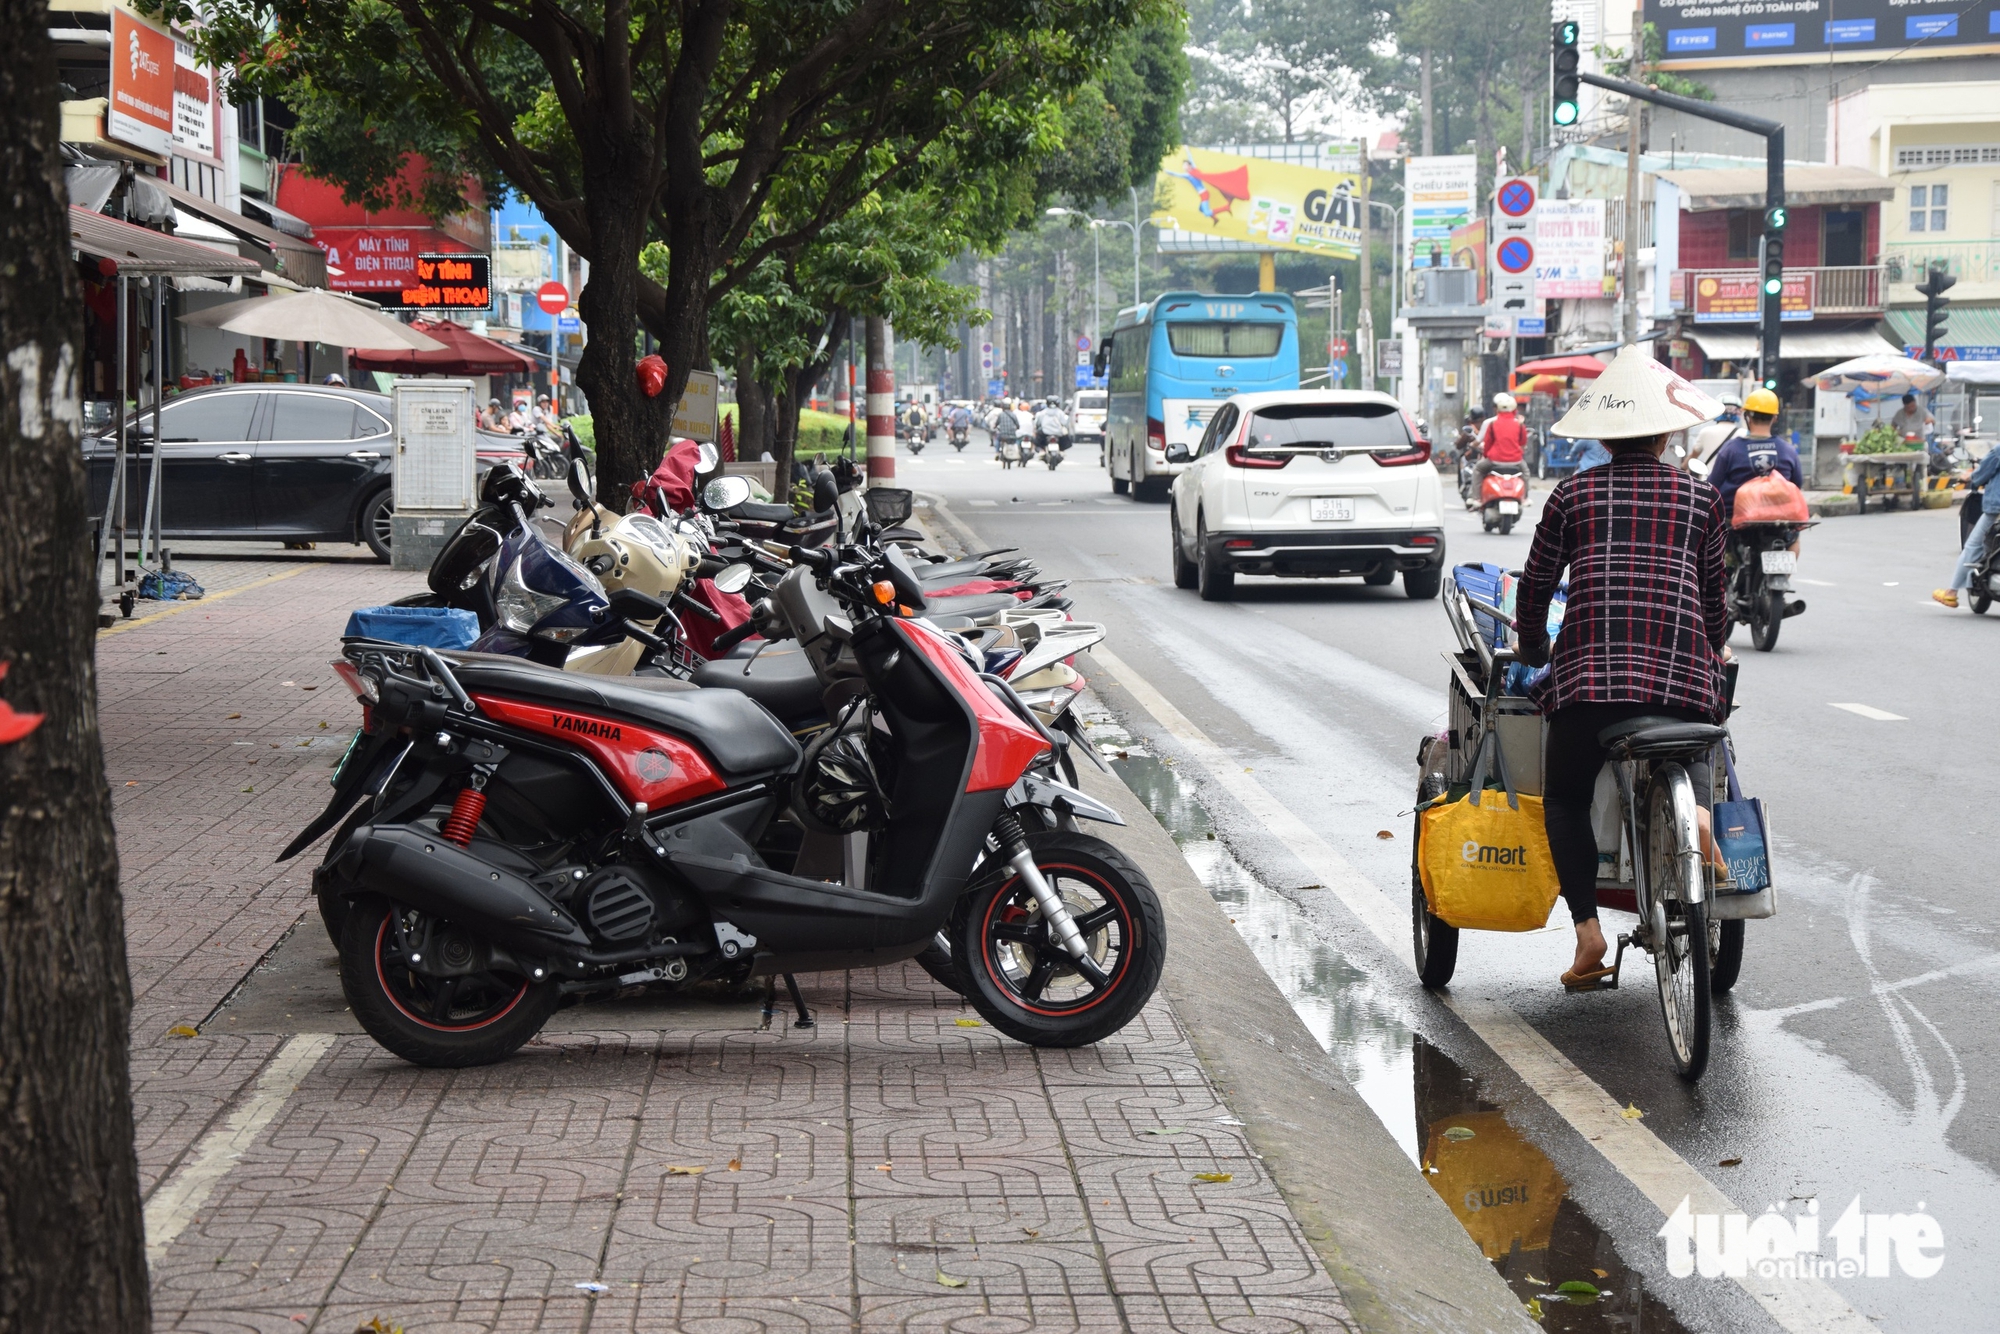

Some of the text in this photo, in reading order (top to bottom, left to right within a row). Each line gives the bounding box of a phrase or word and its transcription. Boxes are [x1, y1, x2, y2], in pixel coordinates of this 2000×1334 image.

[1681, 6, 1712, 18] CÔNG
[1712, 3, 1741, 17] NGHỆ
[1742, 2, 1764, 15] ÔTÔ
[1765, 1, 1794, 13] TOÀN
[358, 236, 410, 252] MÁY TÍNH
[355, 255, 415, 273] ĐIỆN THOẠI
[438, 258, 472, 280] TÍNH
[402, 284, 440, 307] ĐIỆN
[442, 287, 488, 307] THOẠI
[1205, 303, 1245, 319] VIP
[1747, 442, 1777, 451] Ferrari
[1322, 499, 1342, 509] 51H
[1315, 509, 1350, 520] 399.53
[553, 714, 621, 741] YAMAHA
[1462, 840, 1527, 866] emart
